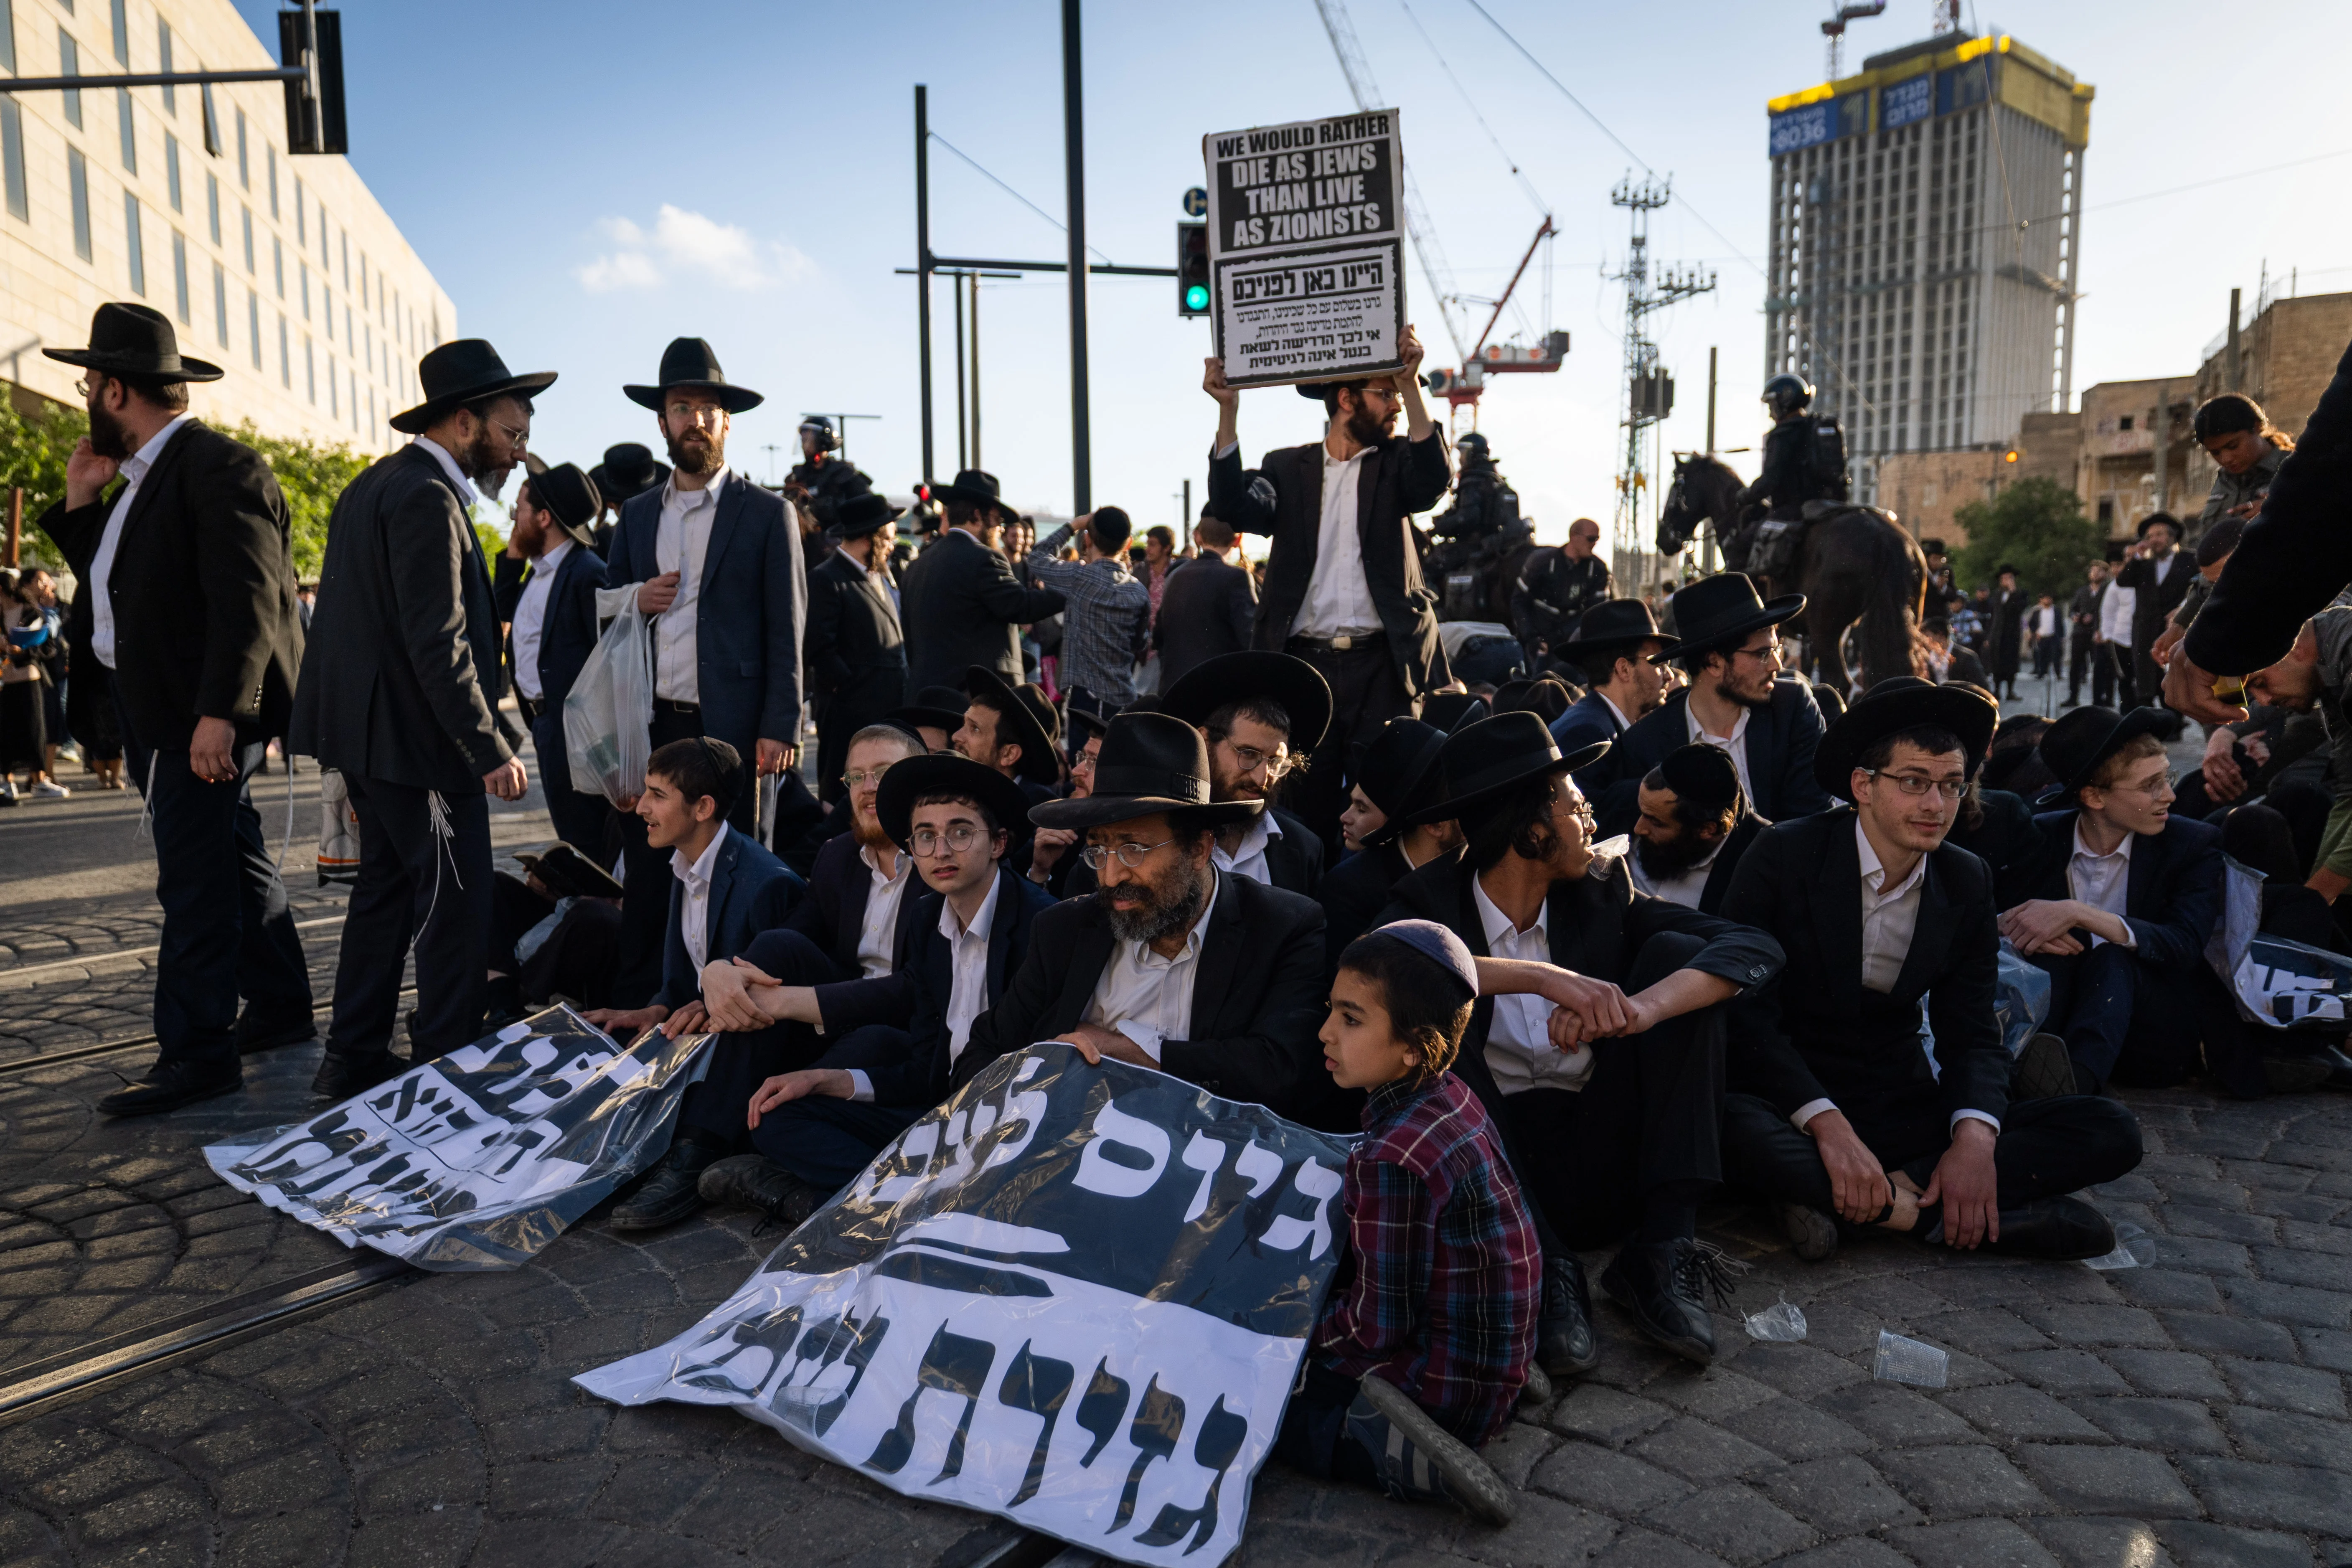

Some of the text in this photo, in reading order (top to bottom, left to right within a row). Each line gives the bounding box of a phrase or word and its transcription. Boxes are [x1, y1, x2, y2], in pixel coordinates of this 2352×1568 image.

[1217, 114, 1389, 158] WE WOULD RATHER
[1232, 142, 1377, 189] DIE AS JEWS
[1245, 174, 1366, 216] THAN LIVE
[1233, 202, 1381, 249] AS ZIONISTS
[1232, 262, 1383, 301] היינו כאן לפניכם
[1306, 302, 1317, 314] כל
[1319, 301, 1331, 313] עם
[1333, 298, 1361, 312] בשלום
[1363, 296, 1382, 308] גרנו
[1237, 308, 1270, 323] התנגדנו
[1256, 314, 1363, 339] להקמת מדינה נגד היהדות,
[1239, 329, 1381, 354] אי לכך הדרישה לשאת
[1249, 345, 1372, 368] בנטל אינה לגיטימית
[1072, 1098, 1343, 1261] גיוס
[862, 1317, 1248, 1557] גזירת
